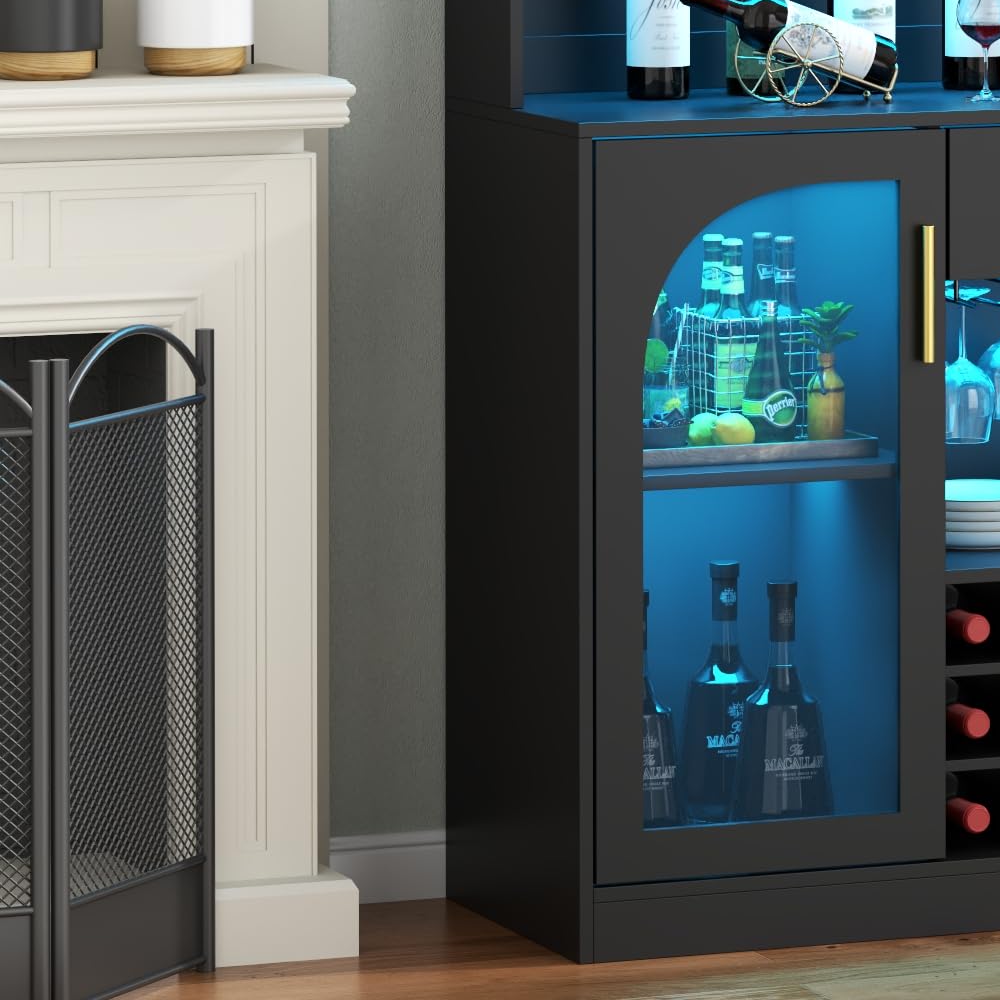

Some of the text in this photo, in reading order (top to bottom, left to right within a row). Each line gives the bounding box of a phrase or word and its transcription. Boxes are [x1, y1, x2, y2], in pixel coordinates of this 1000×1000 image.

[764, 396, 797, 421] Perrier
[706, 734, 741, 748] MACA
[643, 765, 676, 780] ALLAN
